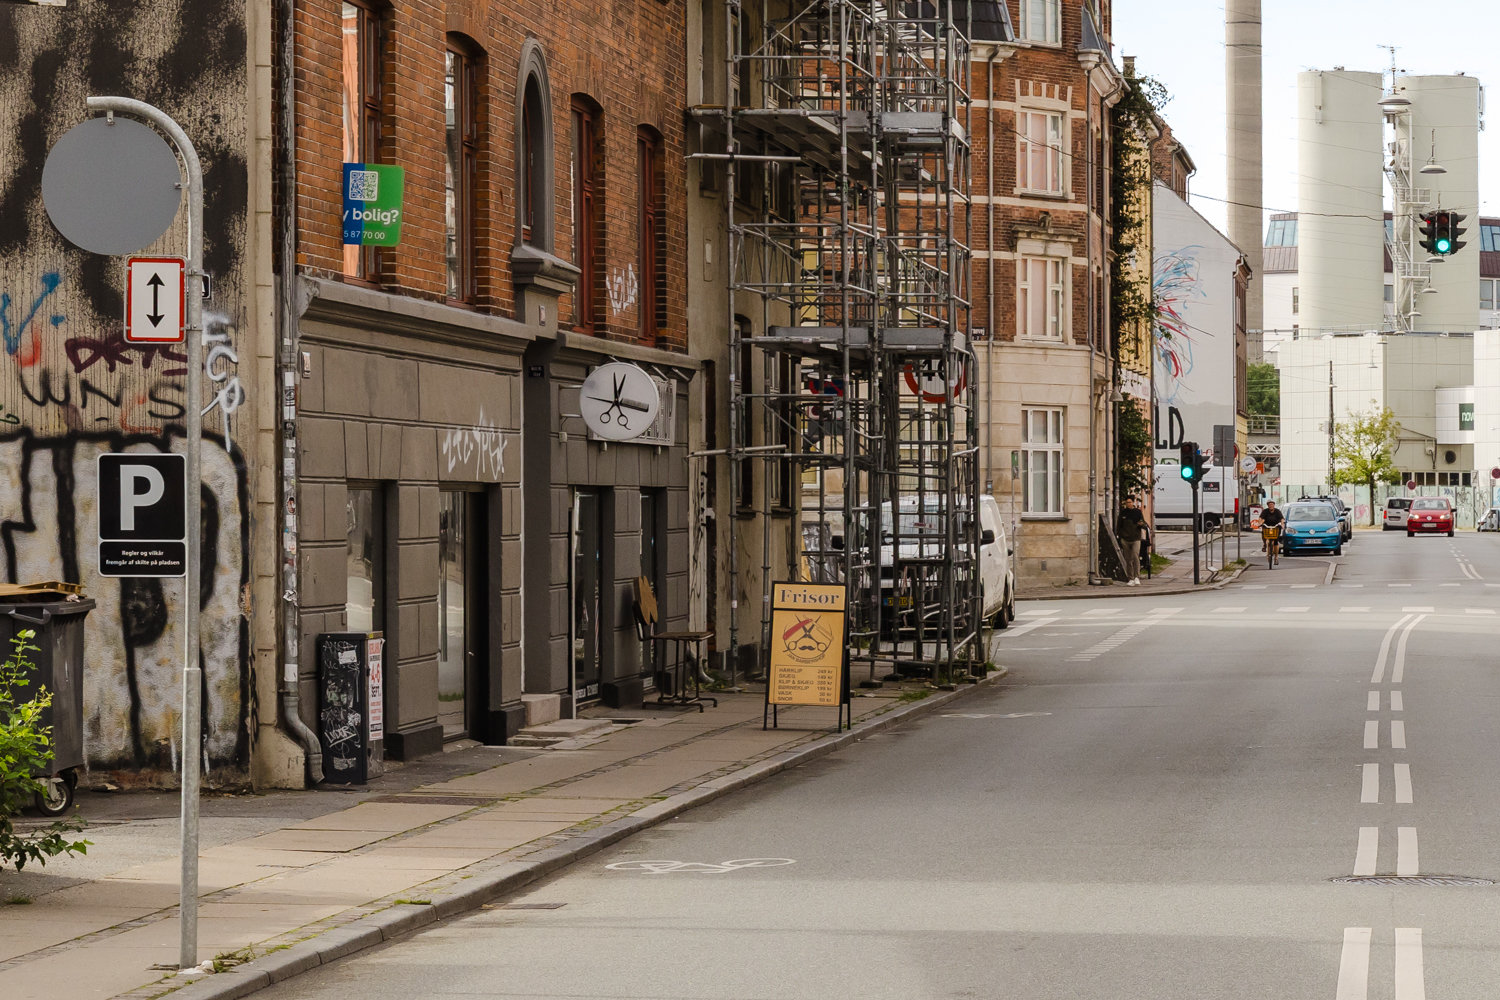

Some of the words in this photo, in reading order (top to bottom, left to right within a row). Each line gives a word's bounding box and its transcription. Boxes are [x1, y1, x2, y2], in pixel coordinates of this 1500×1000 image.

[352, 207, 399, 225] bolig?
[350, 230, 361, 238] 87
[363, 231, 373, 239] 70
[374, 231, 385, 240] 00
[120, 464, 165, 531] P
